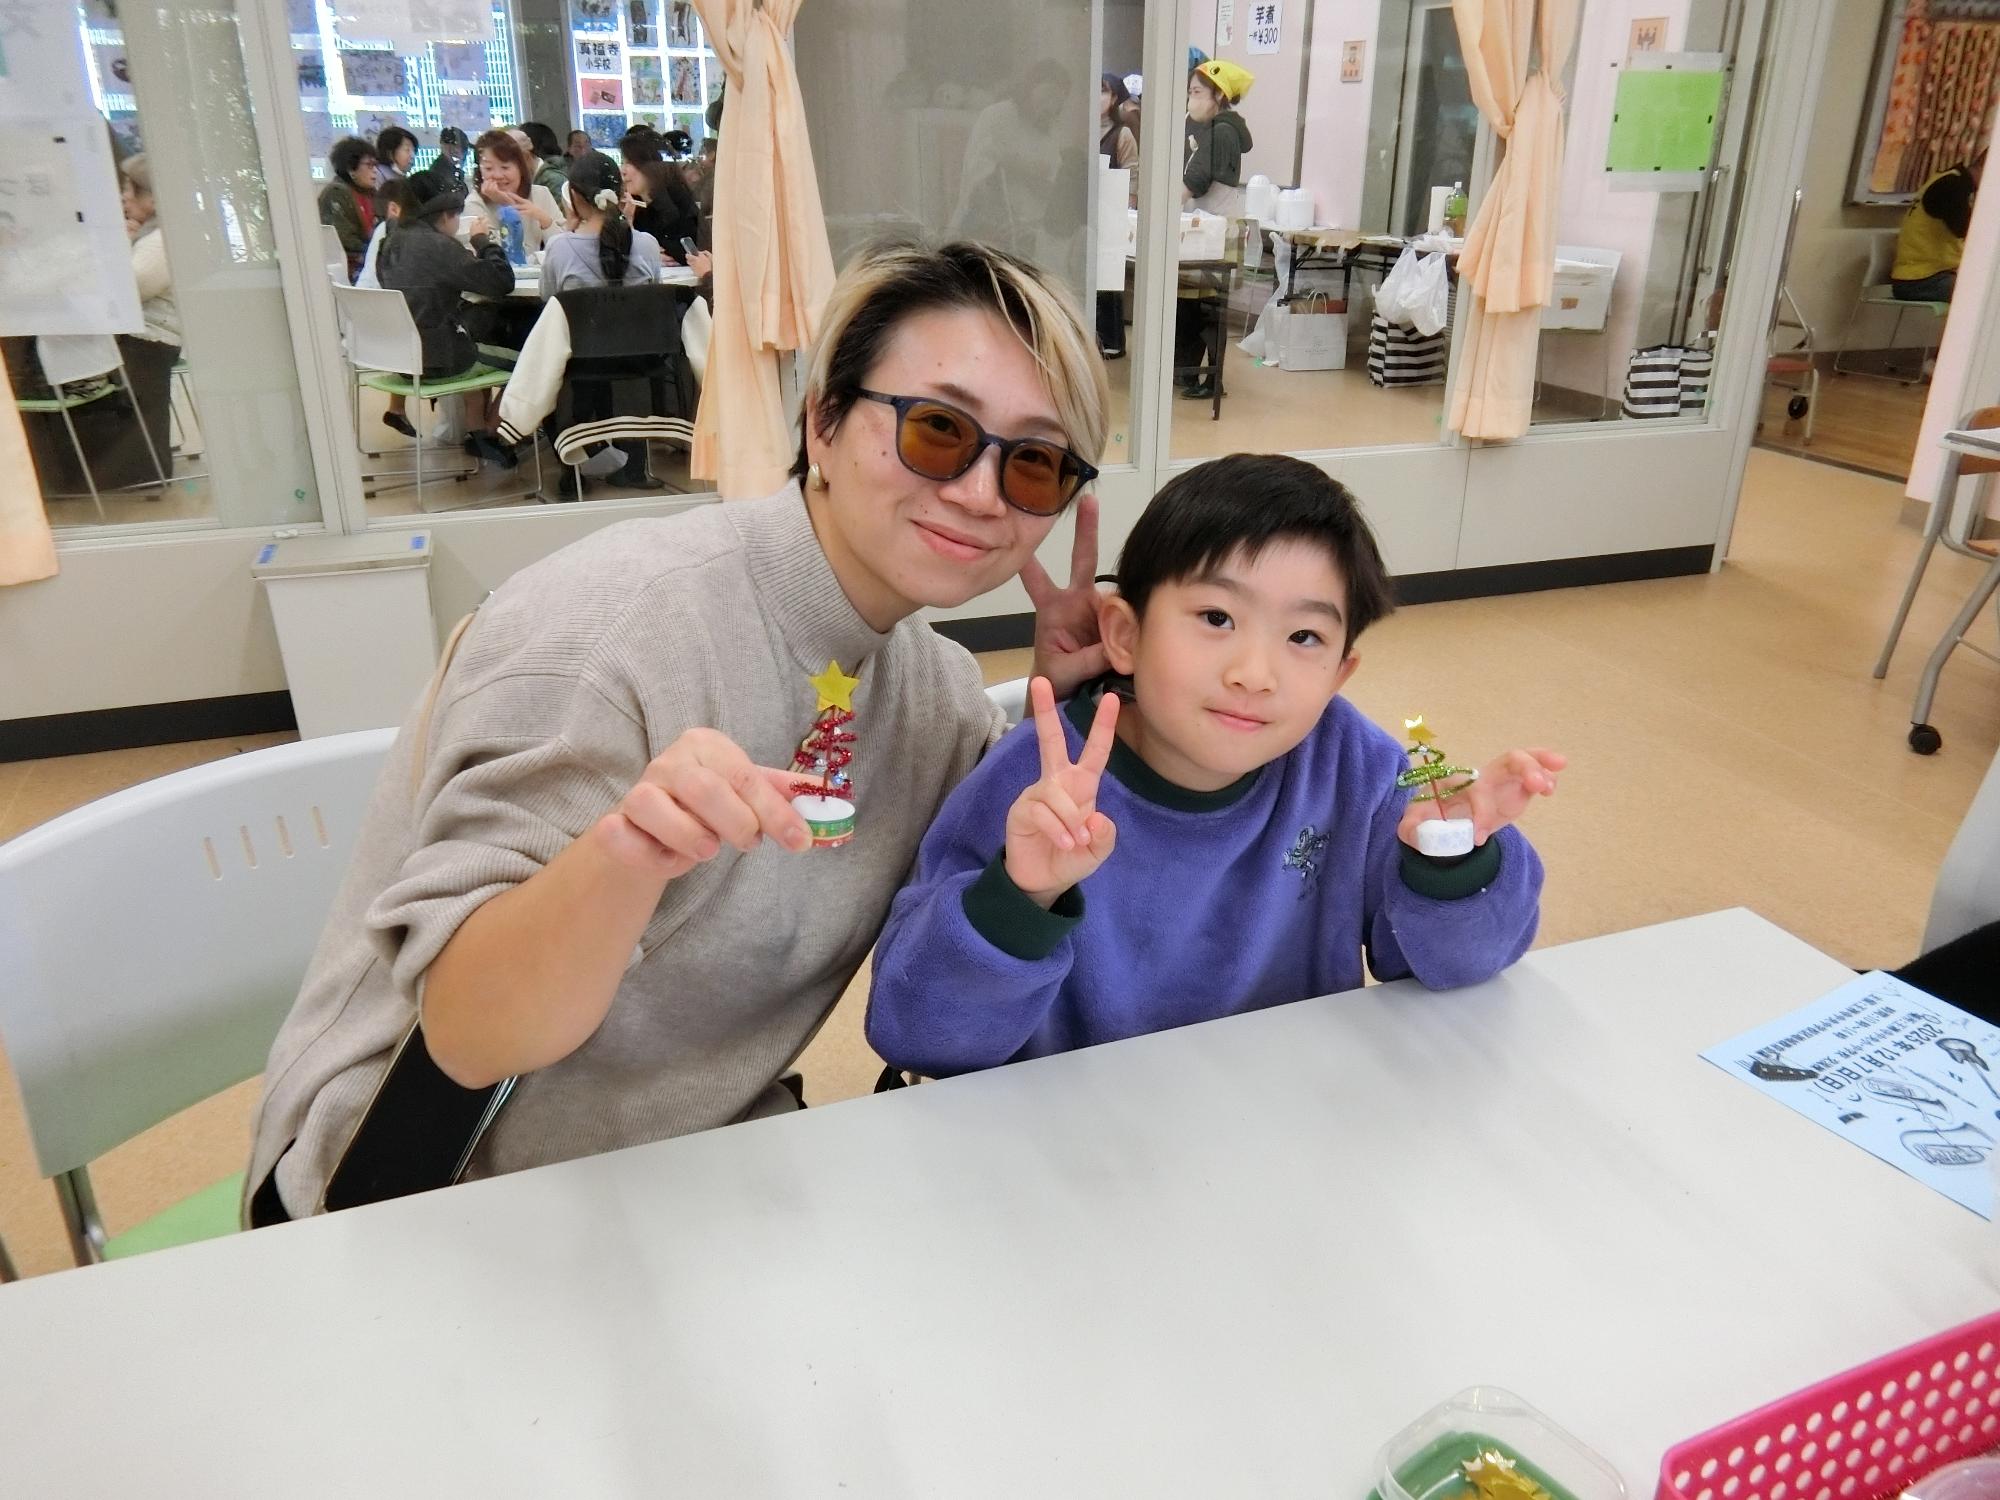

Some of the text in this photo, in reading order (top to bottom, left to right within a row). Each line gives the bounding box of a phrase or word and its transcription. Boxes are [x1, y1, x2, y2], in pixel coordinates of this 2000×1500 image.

[1256, 5, 1275, 25] 芋煮
[1258, 28, 1278, 45] ¥300
[579, 42, 619, 56] 真福寺
[585, 57, 611, 71] 小学校
